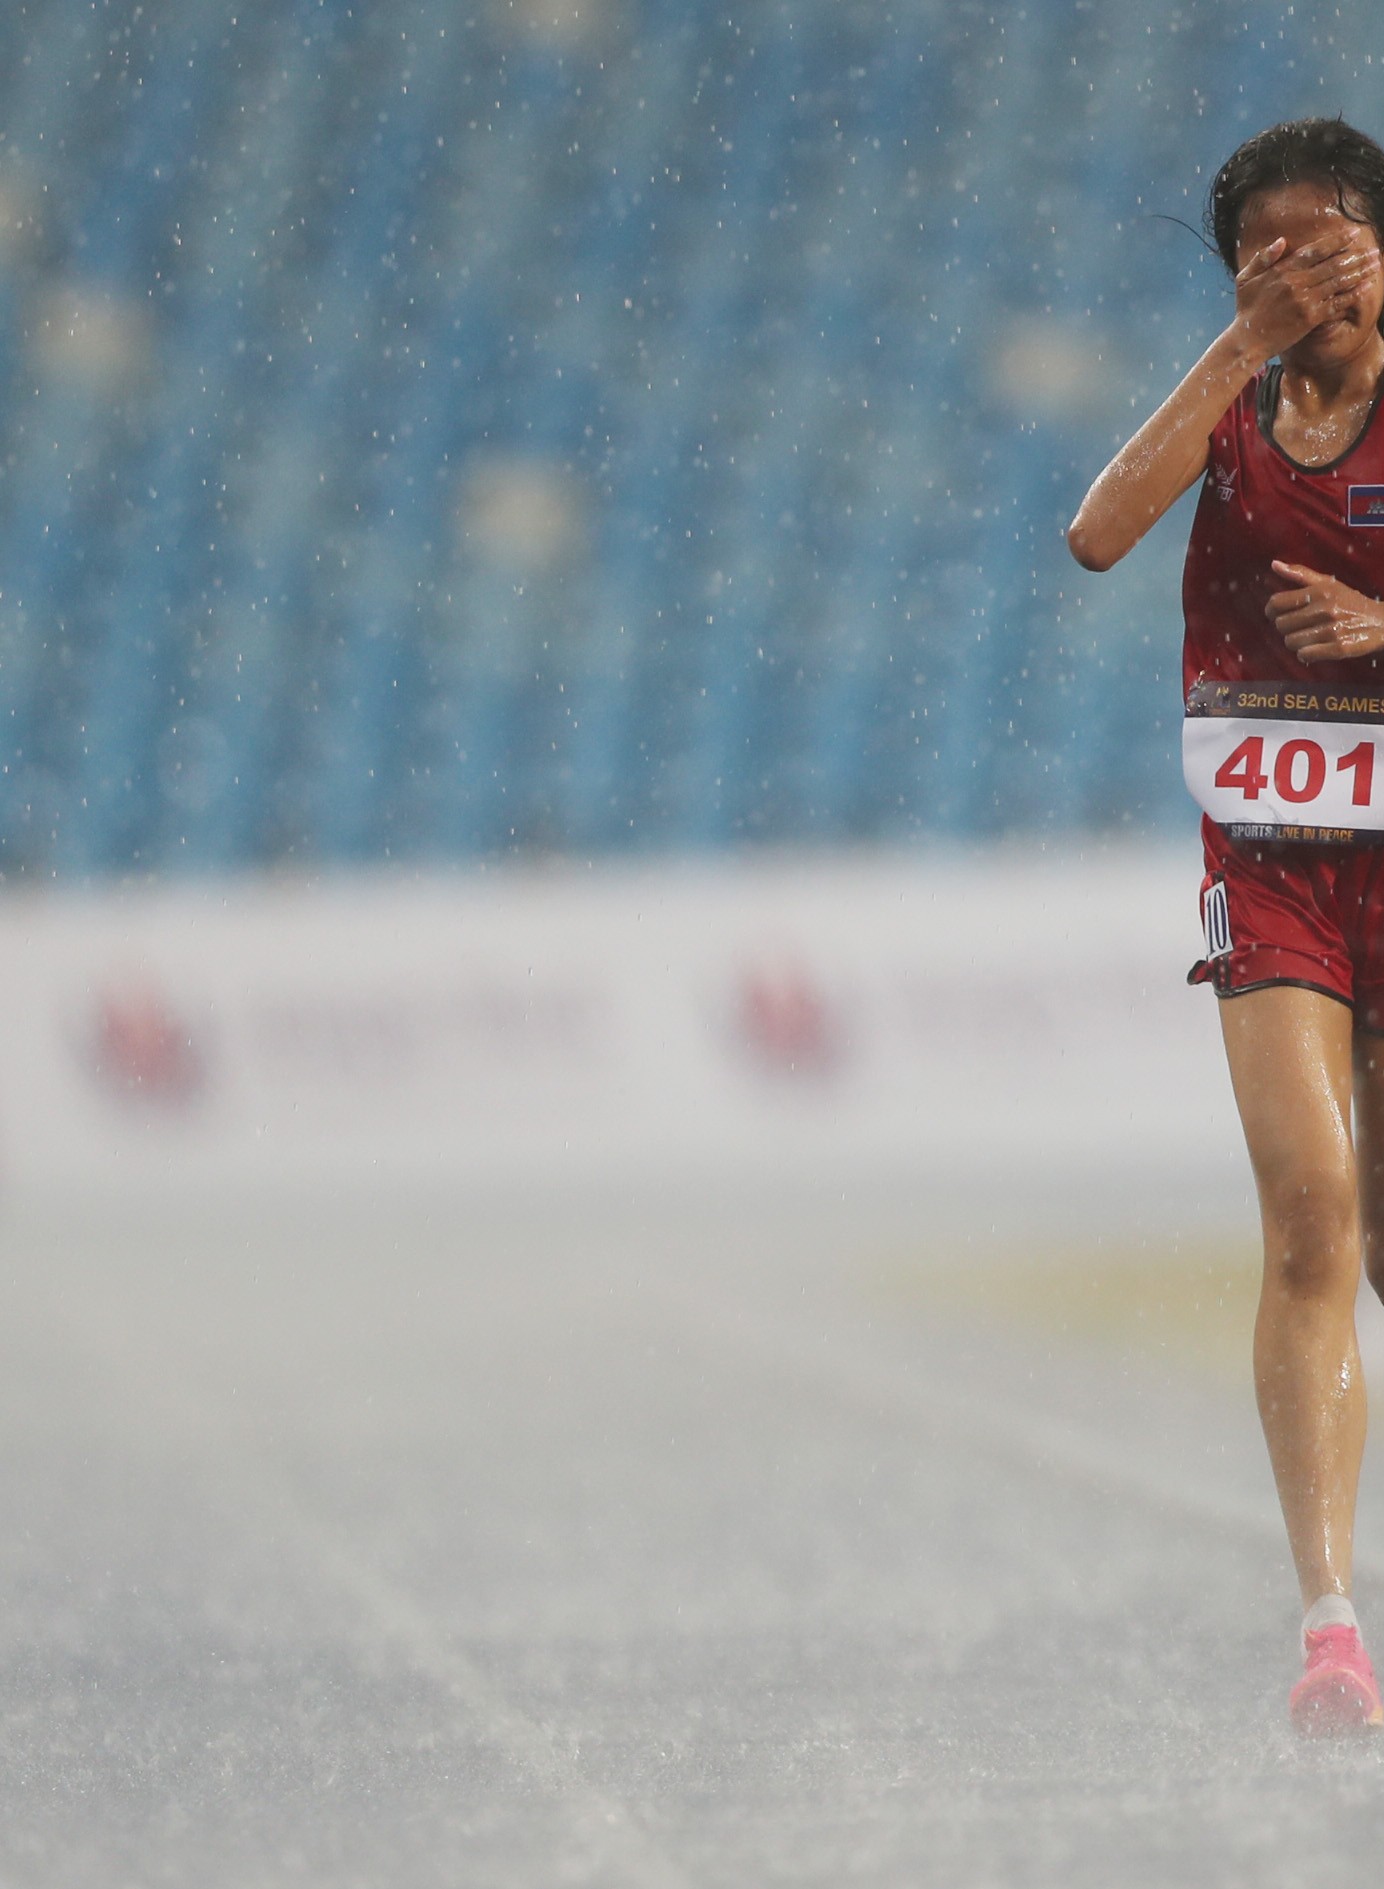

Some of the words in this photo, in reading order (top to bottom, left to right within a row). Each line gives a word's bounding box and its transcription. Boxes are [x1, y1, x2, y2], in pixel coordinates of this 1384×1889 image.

[1237, 693, 1279, 708] 32nd
[1284, 694, 1319, 710] SEA
[1214, 735, 1375, 806] 401
[1231, 824, 1273, 838] SPORTS
[1276, 826, 1299, 839] LIVE
[1303, 827, 1315, 840] IN
[1319, 828, 1355, 842] PEACE
[1207, 888, 1227, 957] 10
